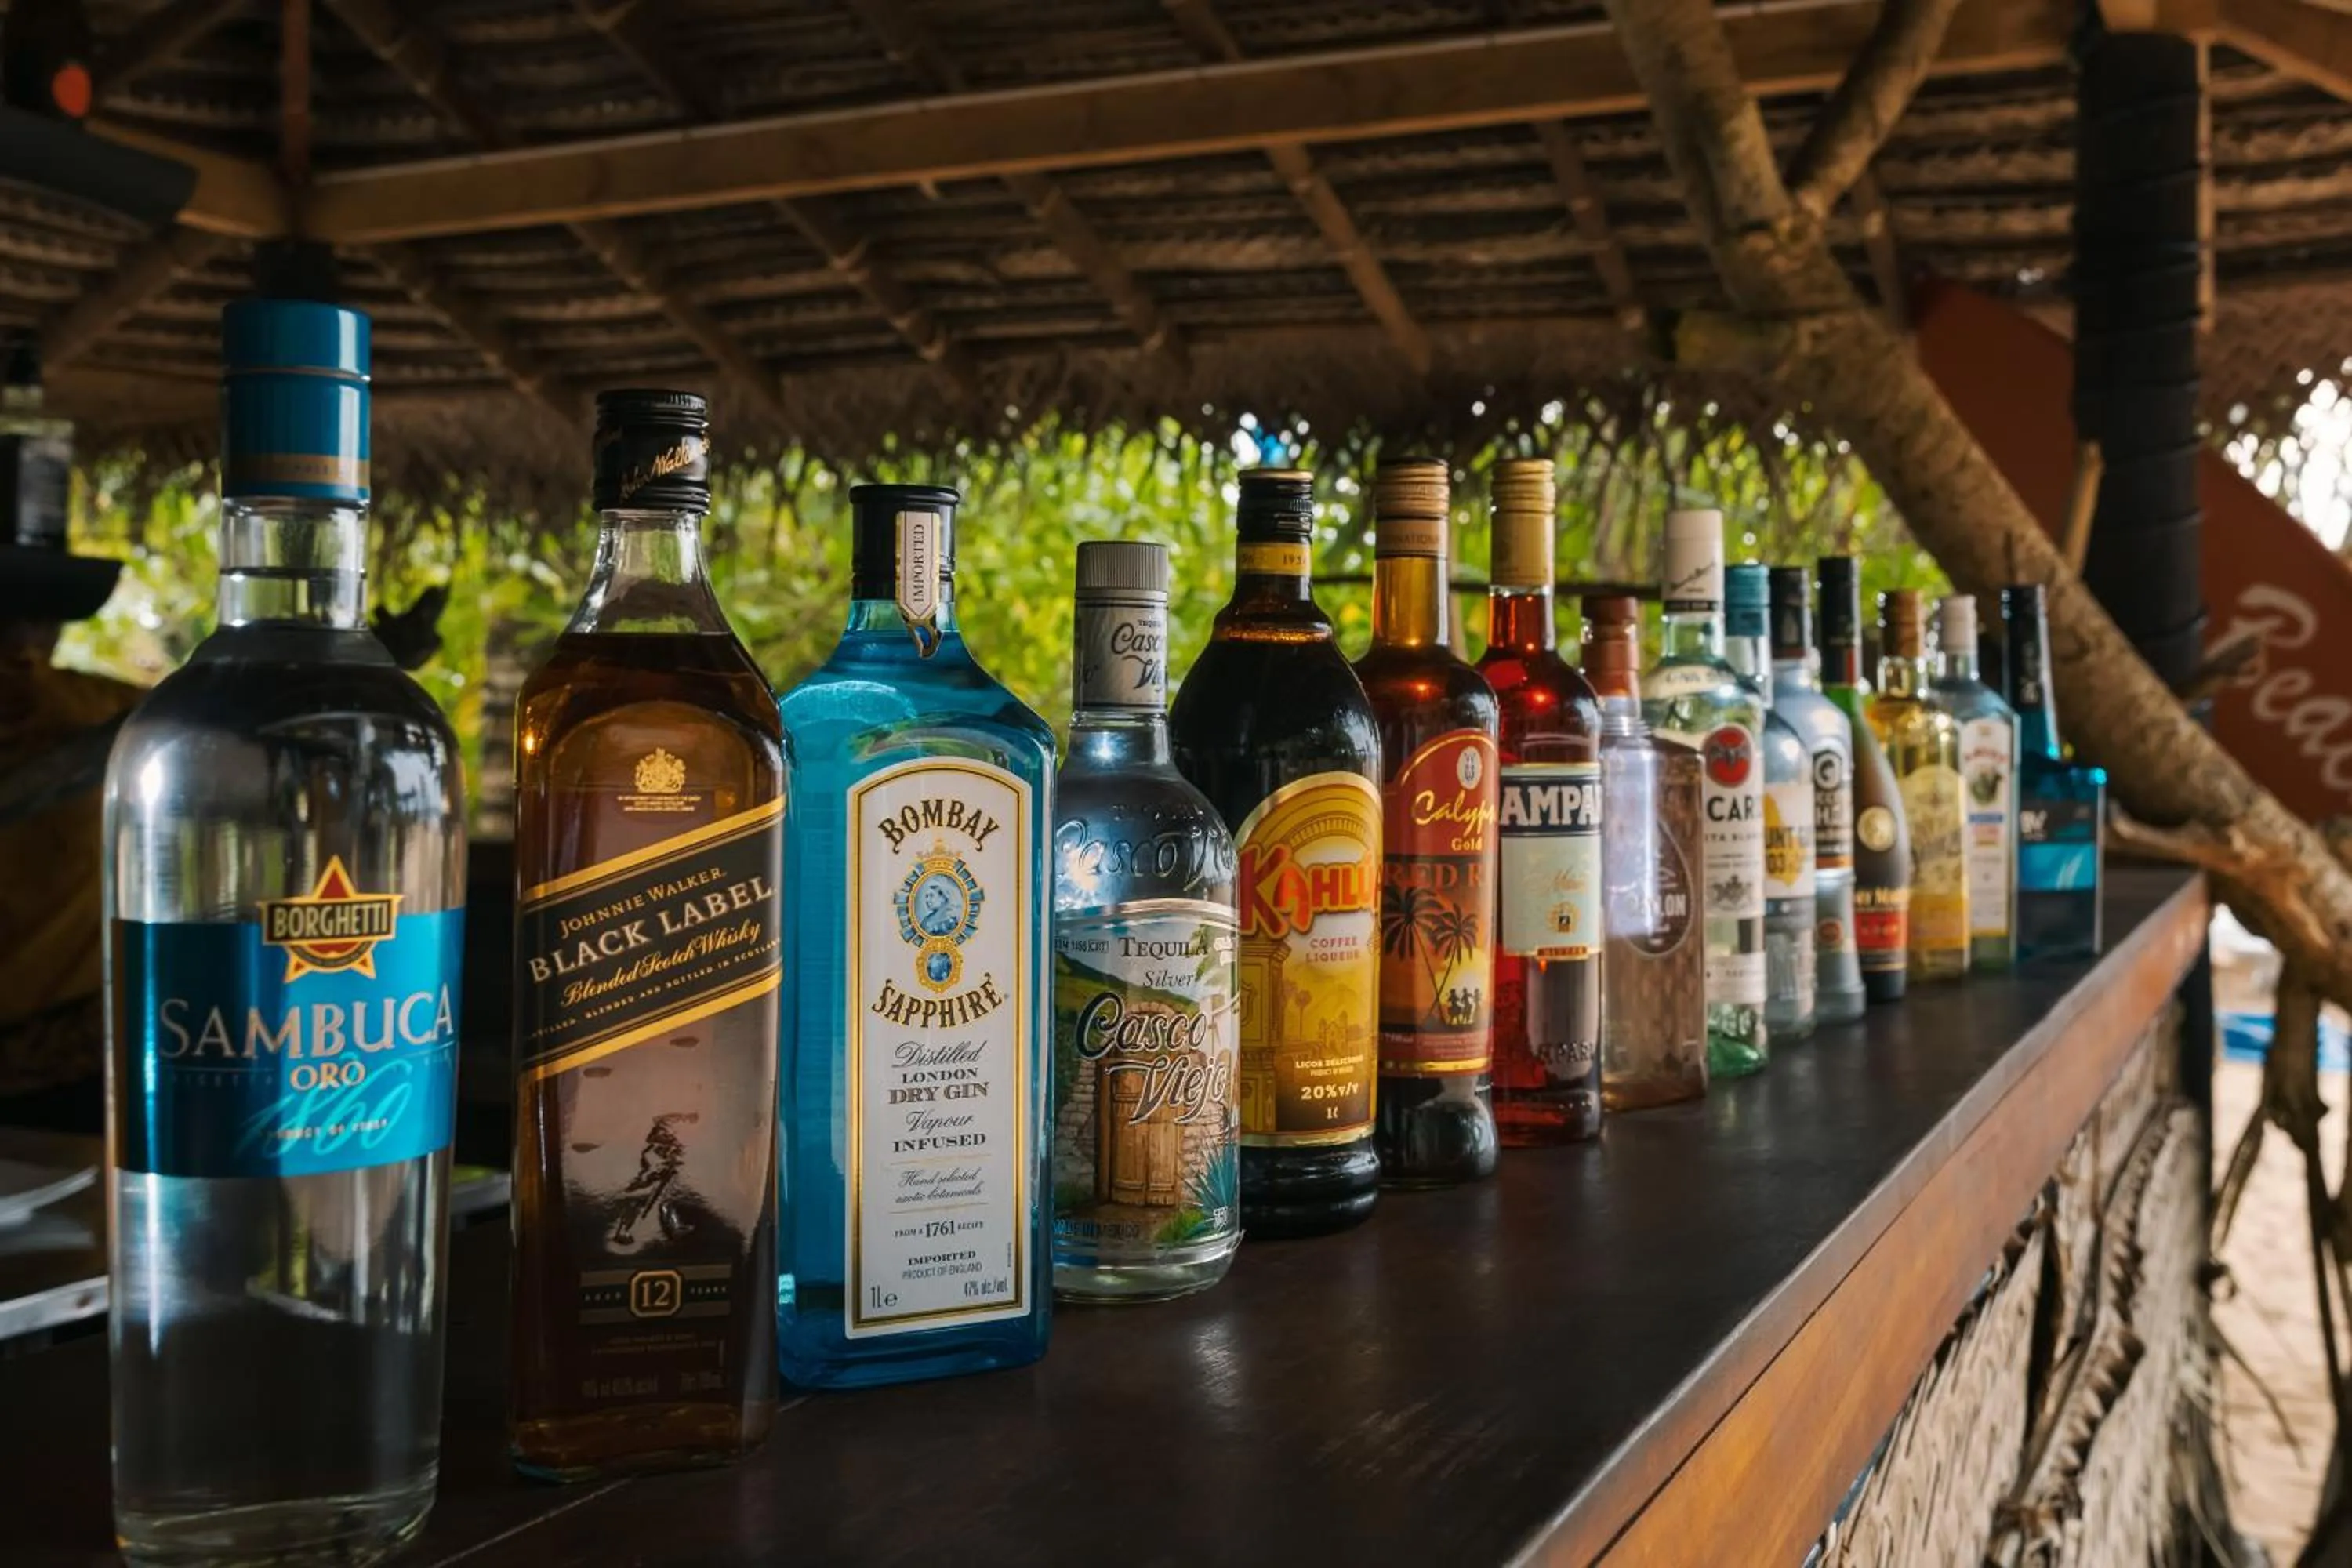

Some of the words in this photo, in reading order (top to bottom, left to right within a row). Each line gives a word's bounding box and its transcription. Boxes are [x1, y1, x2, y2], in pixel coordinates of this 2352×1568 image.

[913, 524, 925, 603] IMPORTED
[1111, 622, 1163, 655] Casc
[877, 799, 1000, 854] BOMBAY
[1450, 837, 1483, 851] Gold
[558, 892, 646, 939] JOHNNIE
[646, 867, 725, 906] WALKER
[274, 902, 390, 938] BORGHETTI
[528, 918, 653, 984] BLACK
[658, 875, 776, 938] LABEL
[1117, 936, 1208, 960] TEQUILA
[1305, 949, 1360, 963] LIQUEUR
[1310, 936, 1358, 949] COFFEE
[560, 965, 641, 1008] Blended
[638, 942, 696, 978] Scotch
[695, 916, 762, 956] Whisky
[585, 996, 635, 1019] BLENDED
[640, 985, 662, 999] AND
[666, 967, 714, 989] BOTTLED
[717, 960, 731, 971] IN
[1142, 968, 1196, 989] Silver
[872, 971, 1003, 1029] SAPPHIRE
[159, 982, 455, 1060] SAMBUCA
[1076, 991, 1208, 1059] Casco
[891, 1040, 988, 1069] Distilled
[290, 1061, 366, 1091] ORO
[901, 1067, 979, 1084] LONDON
[1104, 1054, 1227, 1125] Viejo
[887, 1085, 941, 1105] DRY
[943, 1082, 989, 1100] GIN
[905, 1109, 974, 1136] Vapour
[892, 1132, 987, 1153] INFUSED
[898, 1170, 940, 1188] Hand
[895, 1229, 916, 1239] FROM
[924, 1219, 956, 1239] 1761
[957, 1221, 985, 1231] RECIPE
[902, 1267, 935, 1280] PRODUCT
[936, 1265, 948, 1276] OF
[949, 1261, 983, 1276] ENGLAND
[907, 1250, 977, 1266] IMPORTED
[641, 1279, 672, 1308] 12
